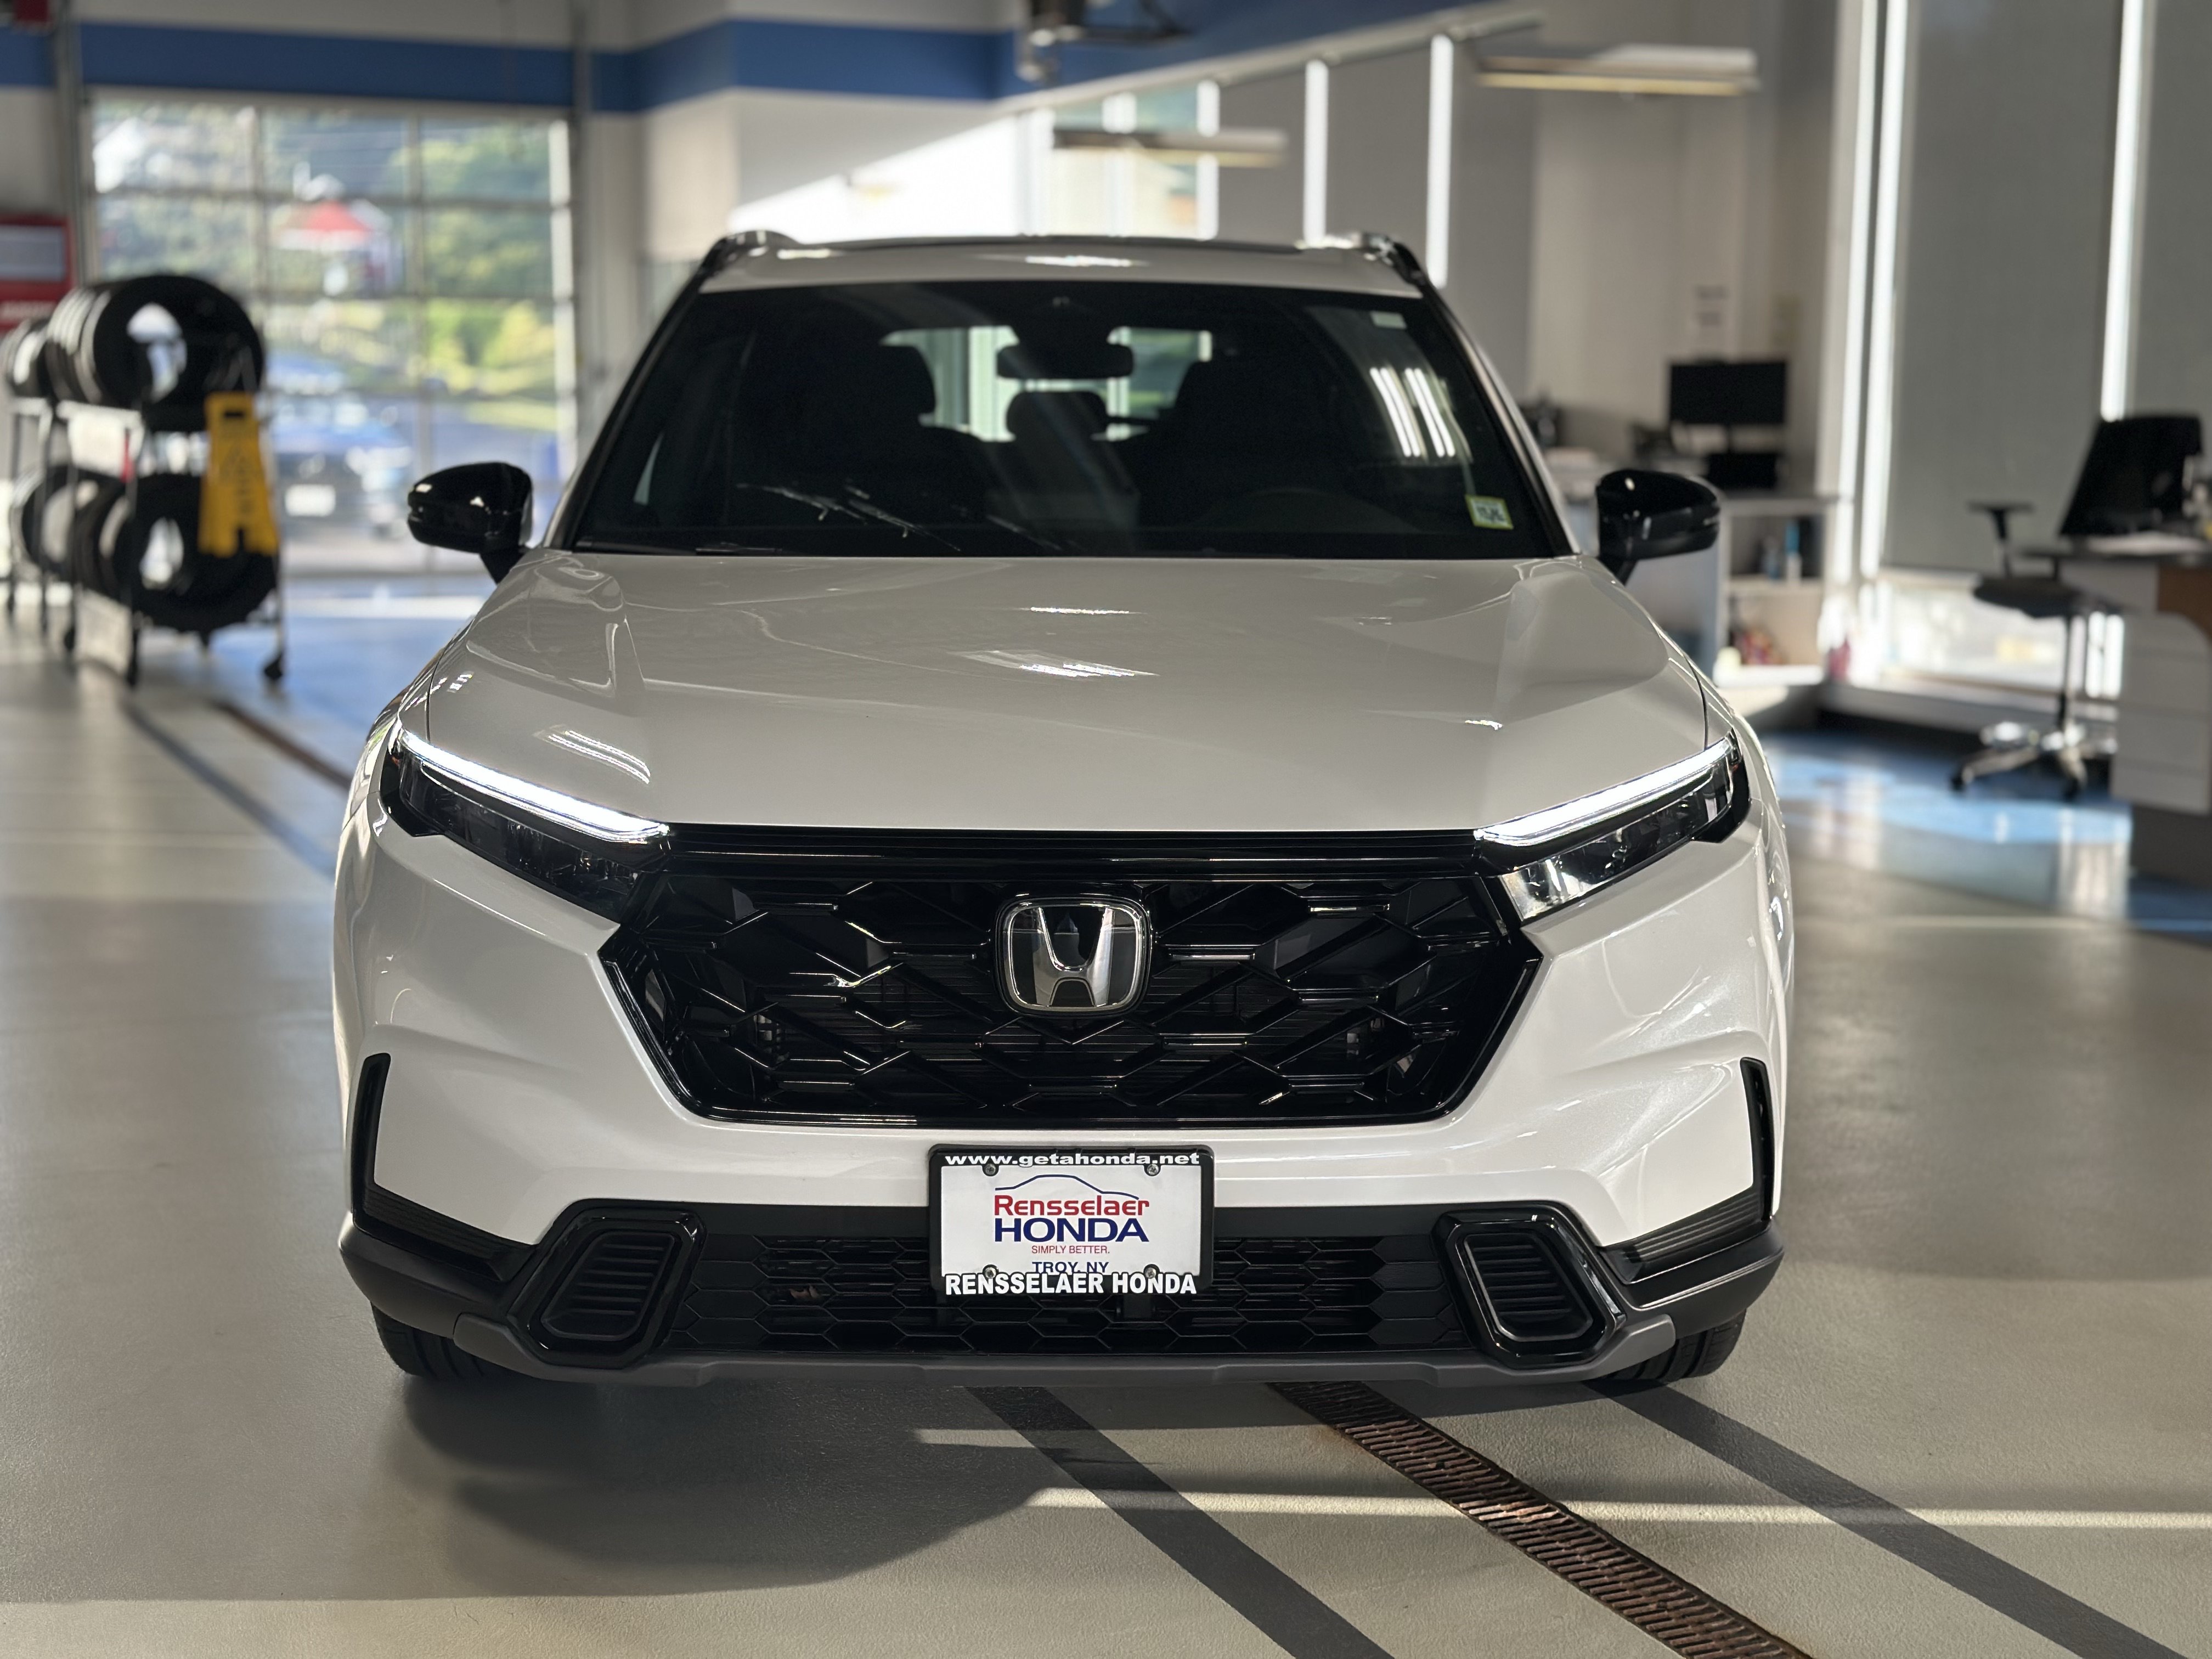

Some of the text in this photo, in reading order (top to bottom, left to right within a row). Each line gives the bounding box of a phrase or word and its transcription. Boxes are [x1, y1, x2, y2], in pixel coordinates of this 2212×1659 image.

[945, 1153, 1199, 1167] www.getahonda.net
[994, 1195, 1149, 1216] Rensselaer
[995, 1218, 1149, 1242] HONDA
[1031, 1245, 1110, 1254] SIMPLY BETTER.
[1087, 1261, 1109, 1273] NY
[946, 1274, 1197, 1295] RENSSELAER HONDA
